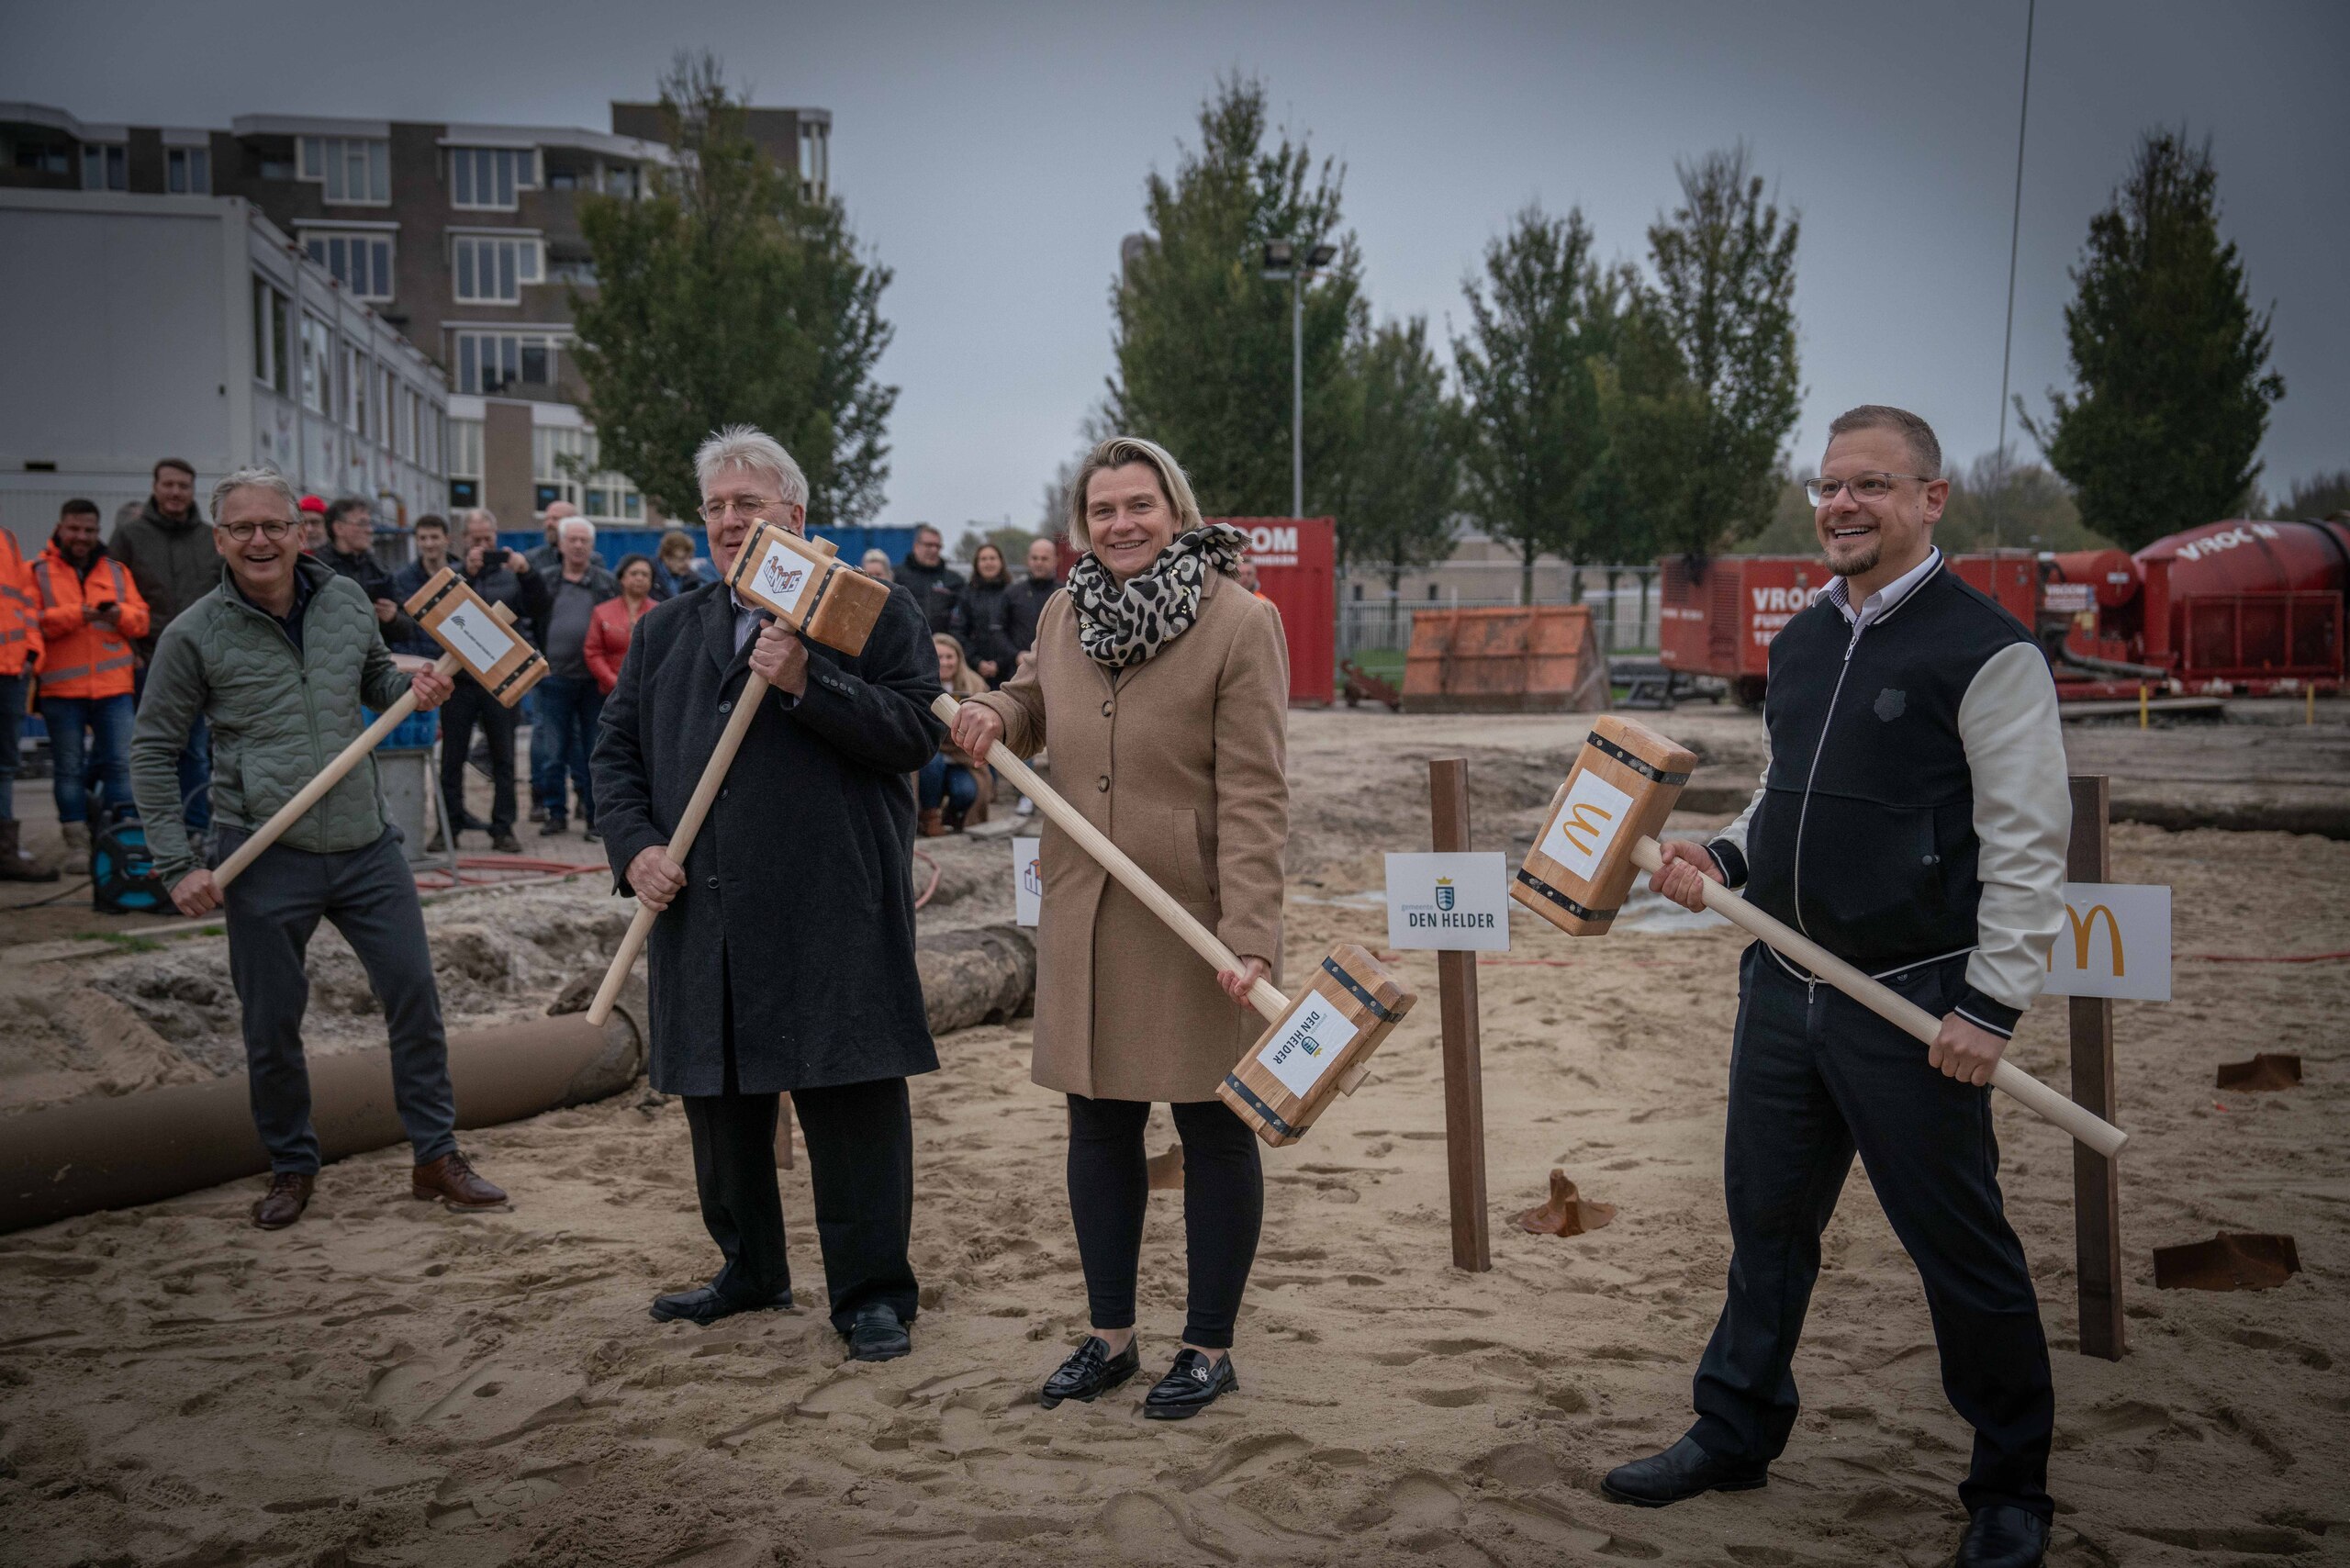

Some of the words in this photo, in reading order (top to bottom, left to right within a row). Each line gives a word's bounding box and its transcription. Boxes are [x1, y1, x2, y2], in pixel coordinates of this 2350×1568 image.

[1401, 903, 1434, 912] gemeente
[1409, 913, 1438, 927] DEN
[1442, 913, 1494, 928] HELDER
[1300, 1011, 1320, 1033] DEN
[1272, 1029, 1304, 1065] HELDER
